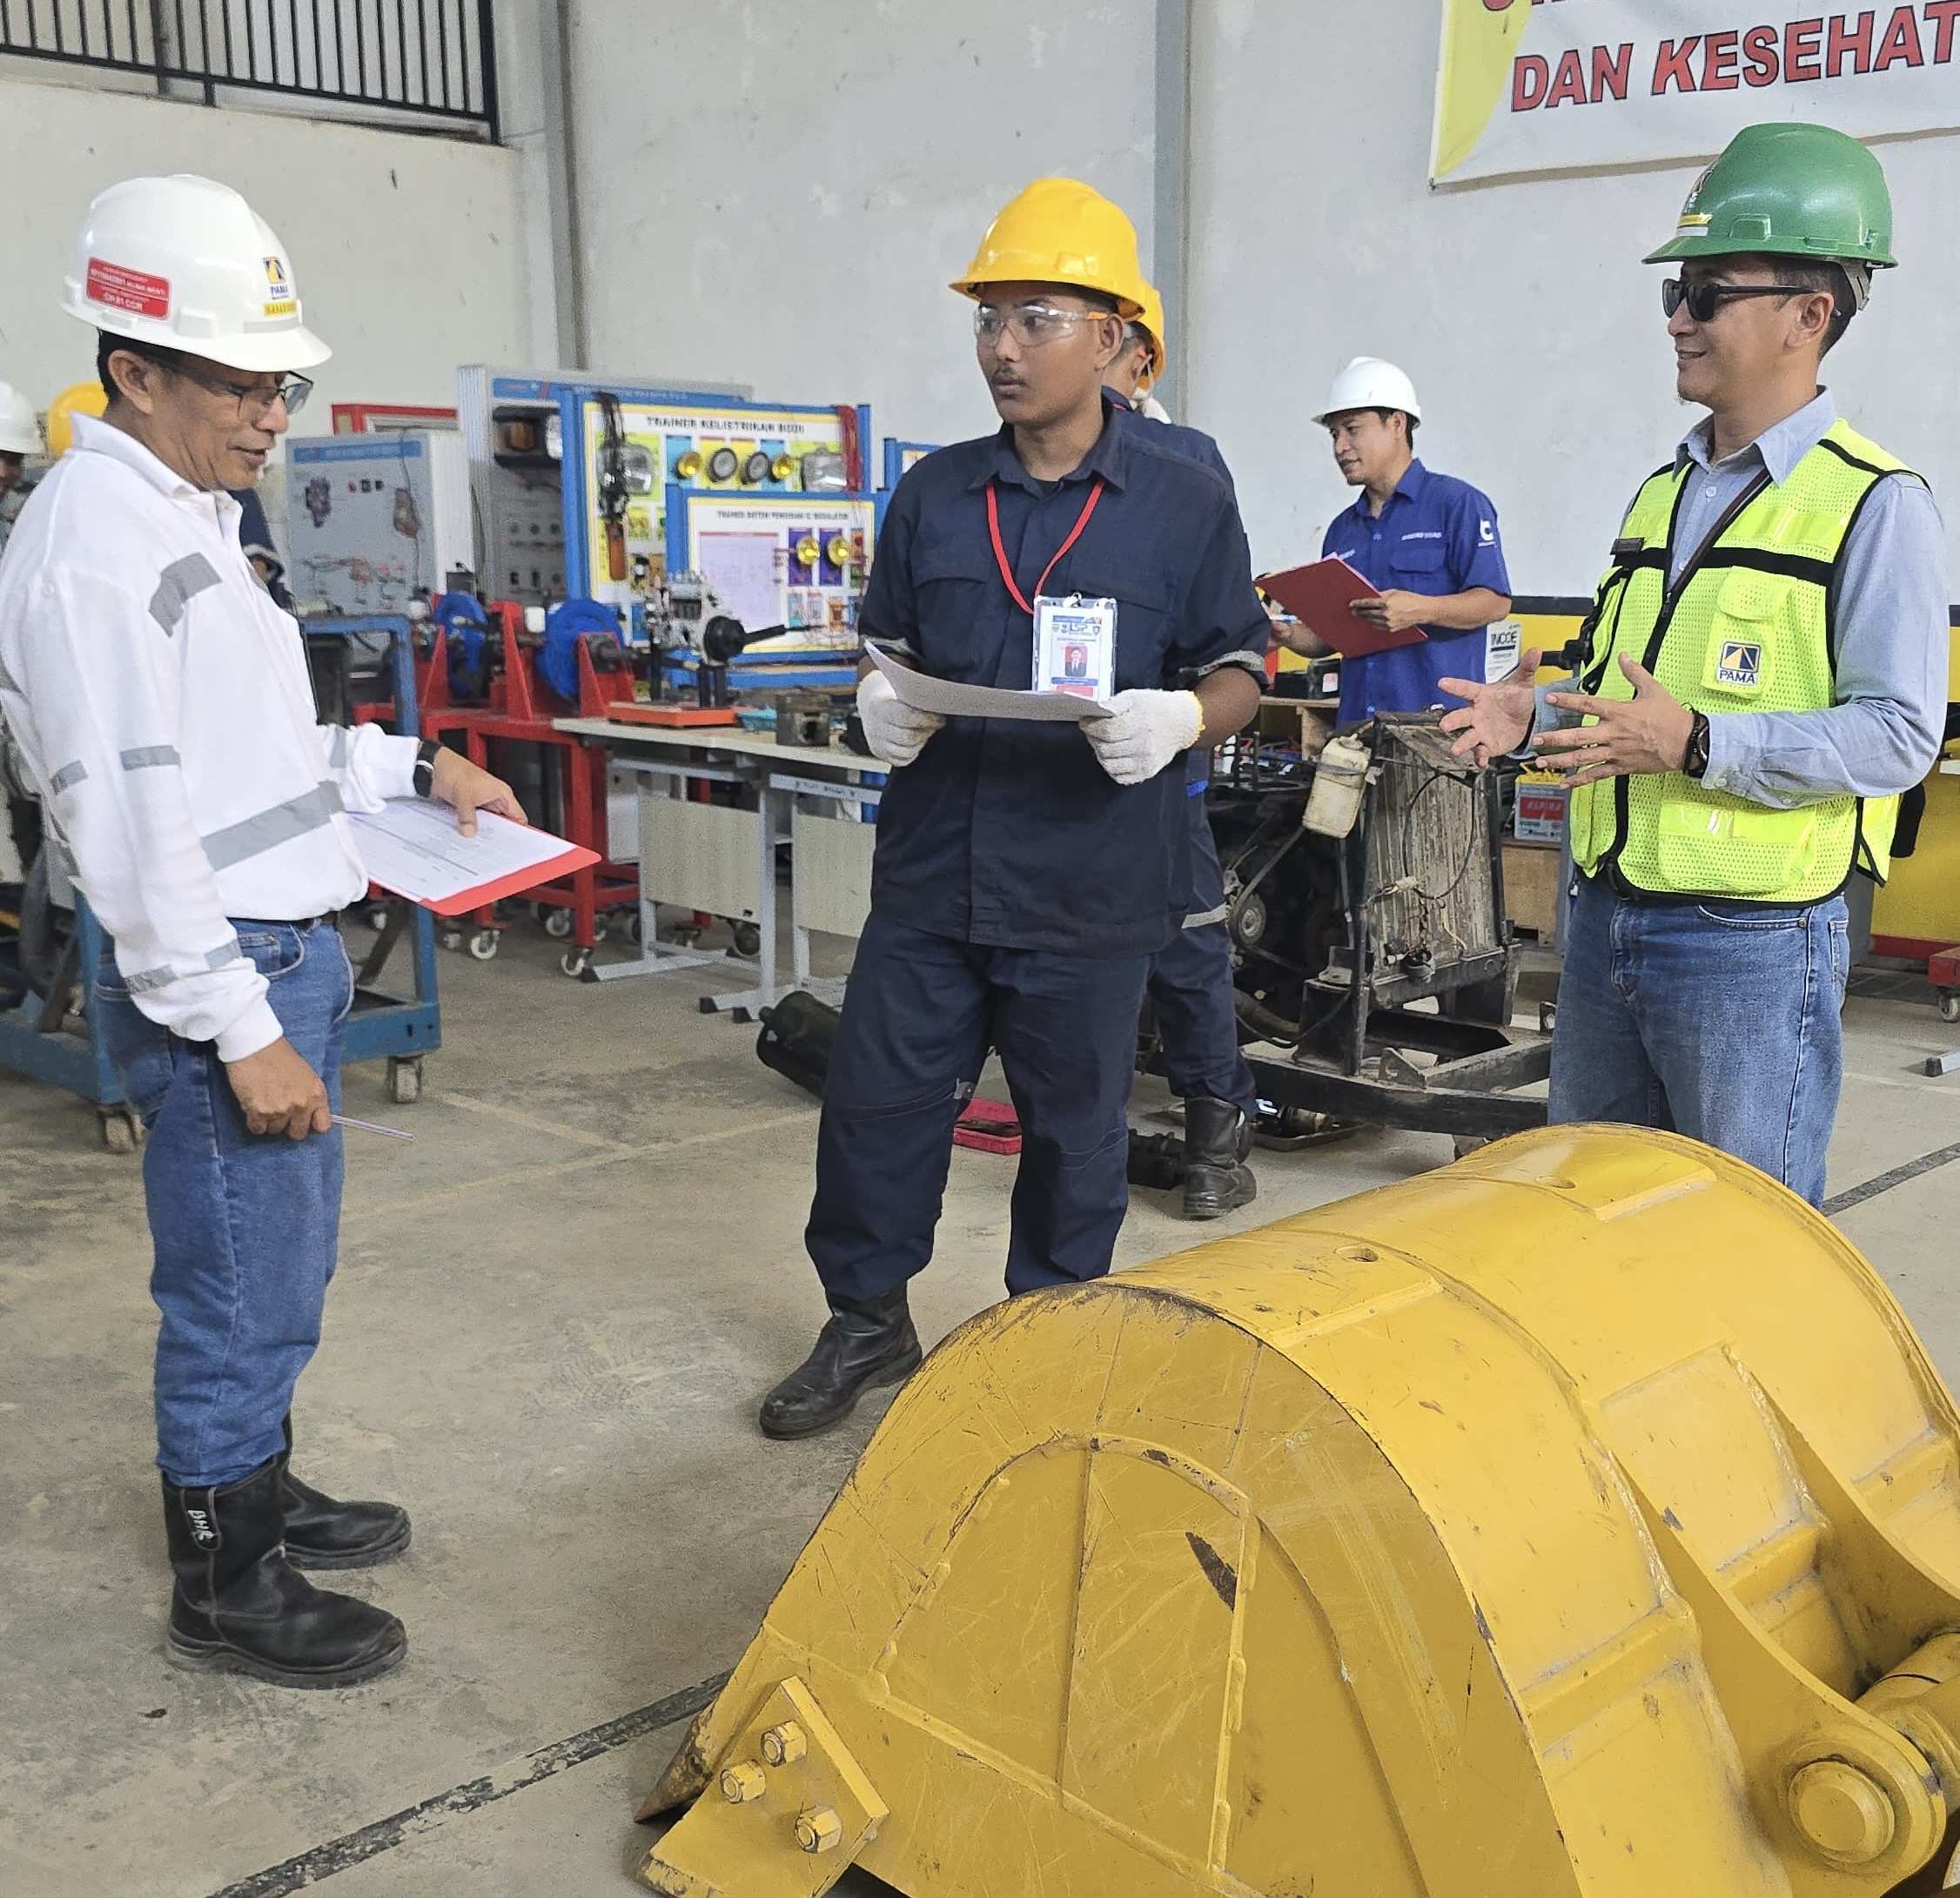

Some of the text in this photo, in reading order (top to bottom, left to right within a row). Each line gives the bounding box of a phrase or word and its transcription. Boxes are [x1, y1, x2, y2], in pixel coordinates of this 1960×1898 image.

[1510, 0, 1960, 112] DAN KESEHAT
[647, 416, 697, 428] TRAINER
[1719, 670, 1755, 683] PAMA
